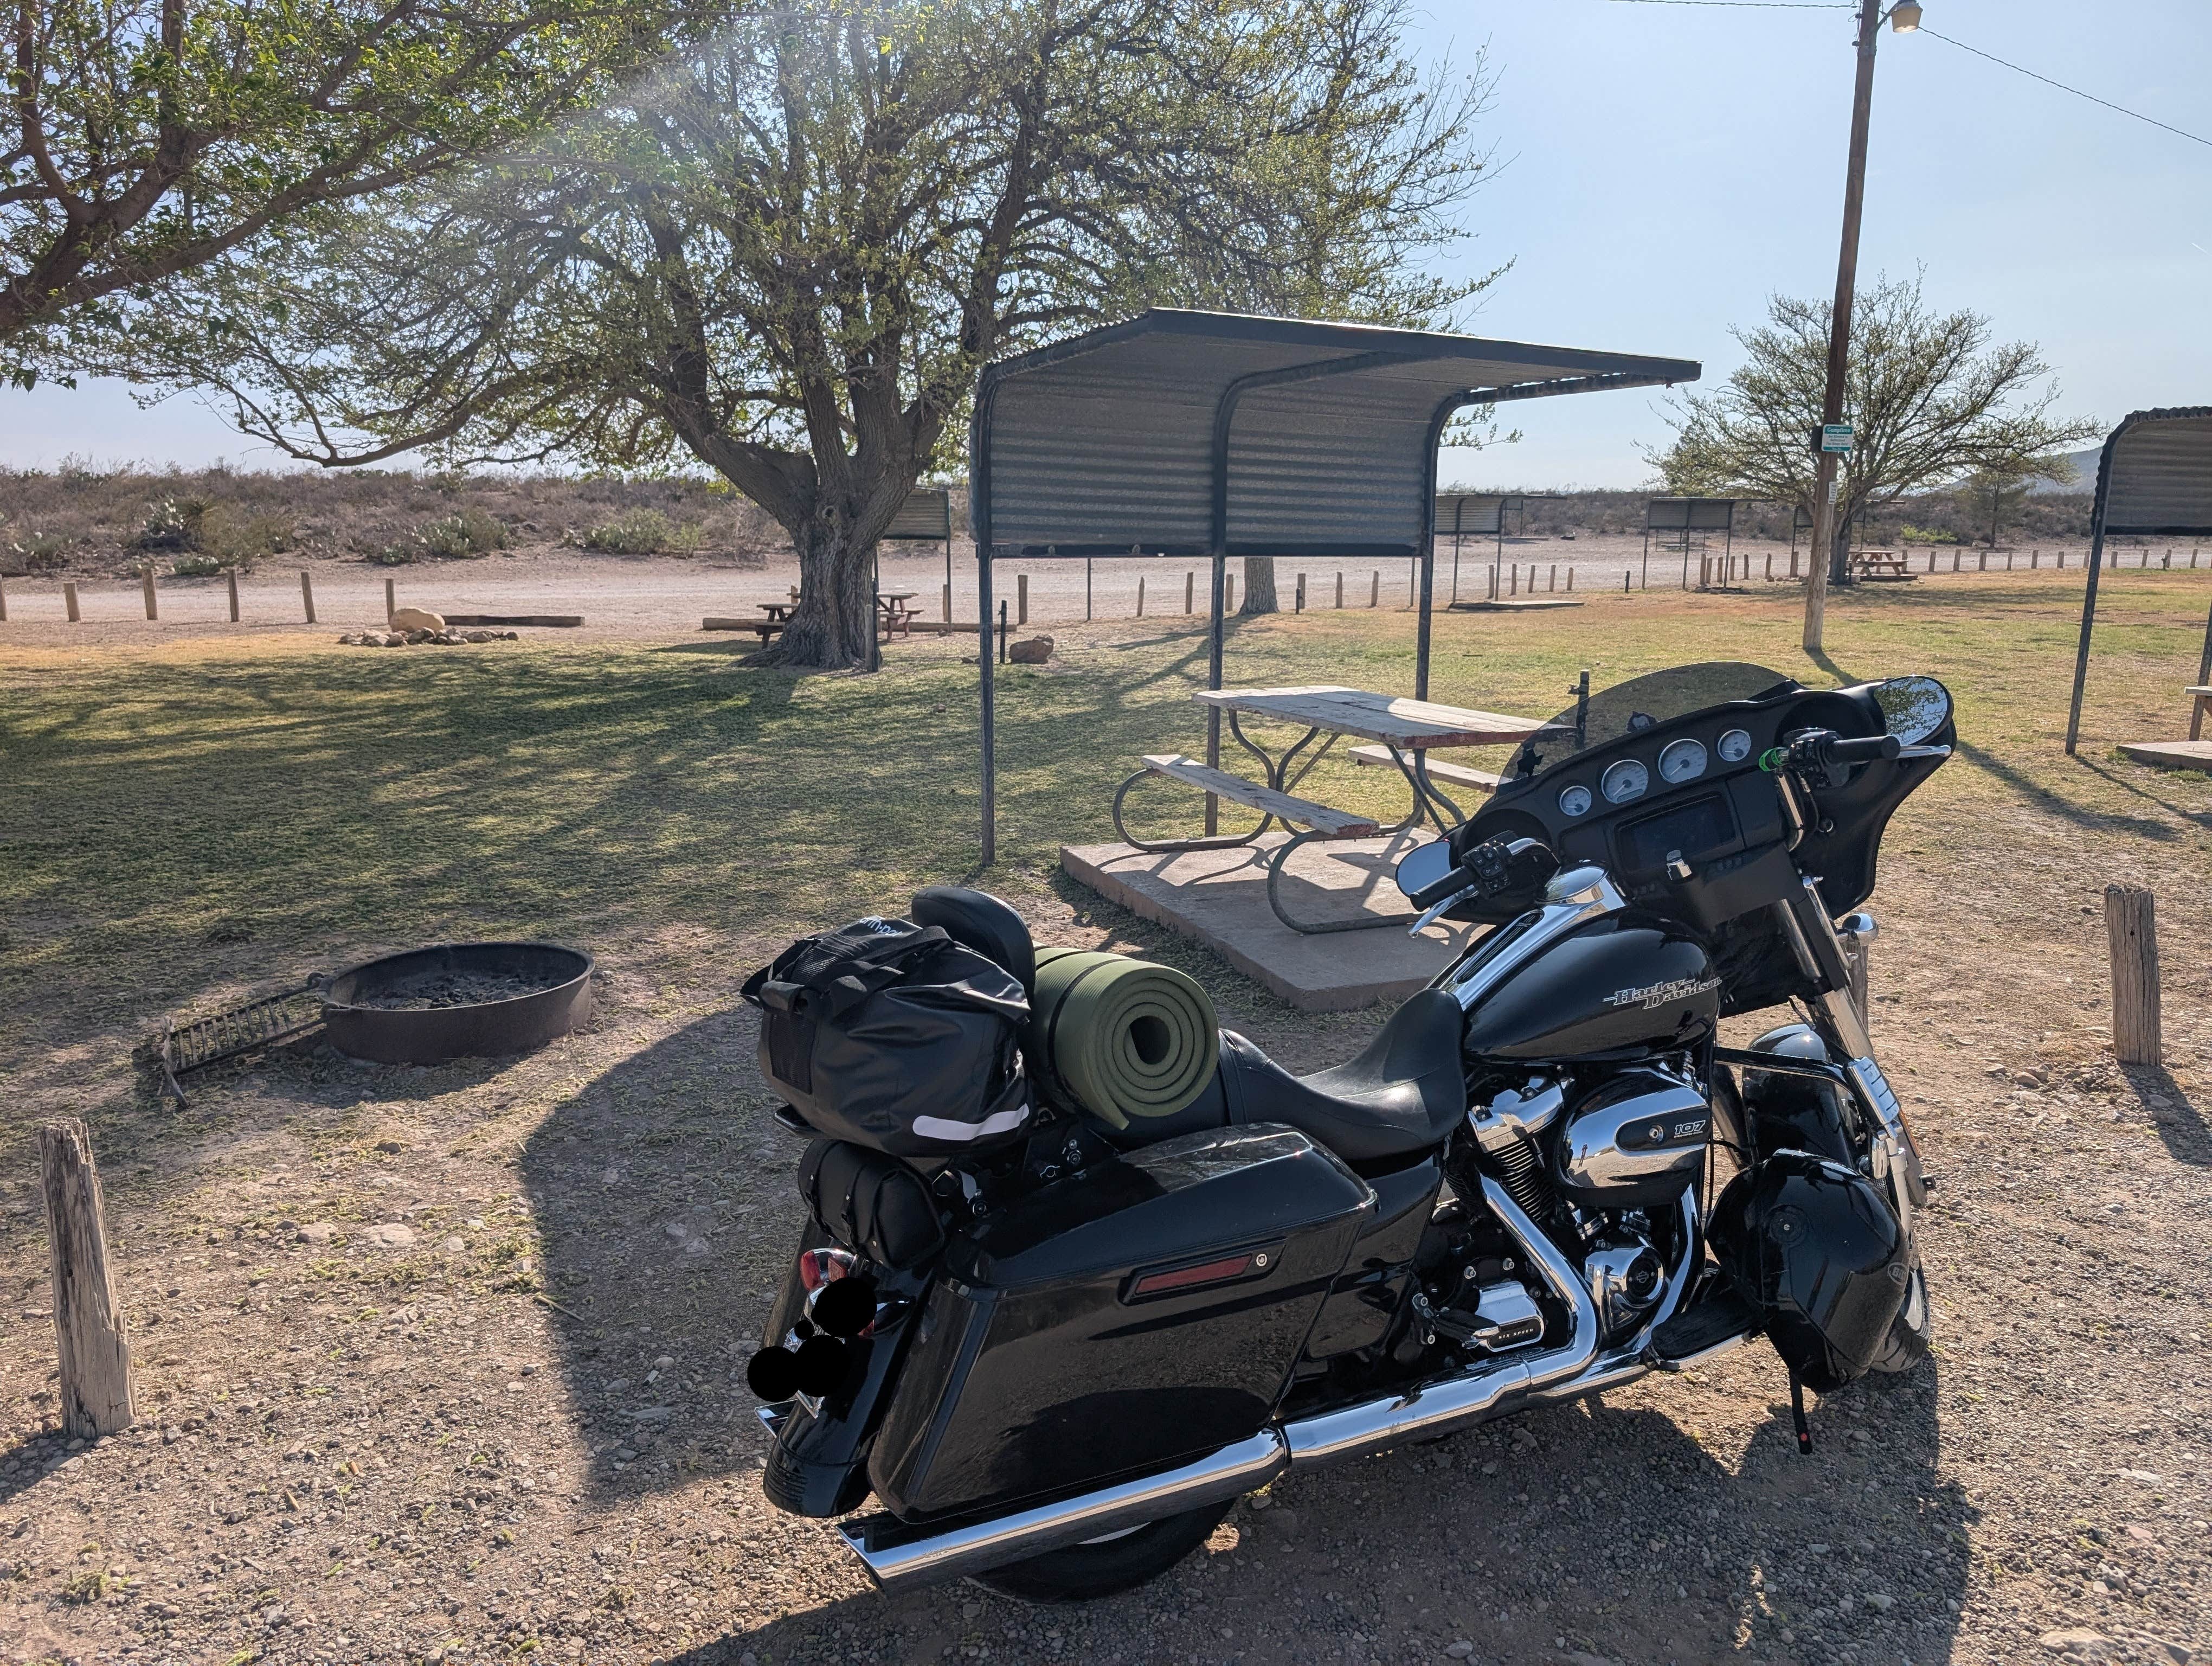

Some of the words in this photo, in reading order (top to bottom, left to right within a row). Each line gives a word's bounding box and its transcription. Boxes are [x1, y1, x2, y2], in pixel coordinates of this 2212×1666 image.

[1643, 977, 1722, 1009] Davidson
[1675, 1120, 1706, 1135] 107
[1513, 1328, 1533, 1336] SPEED
